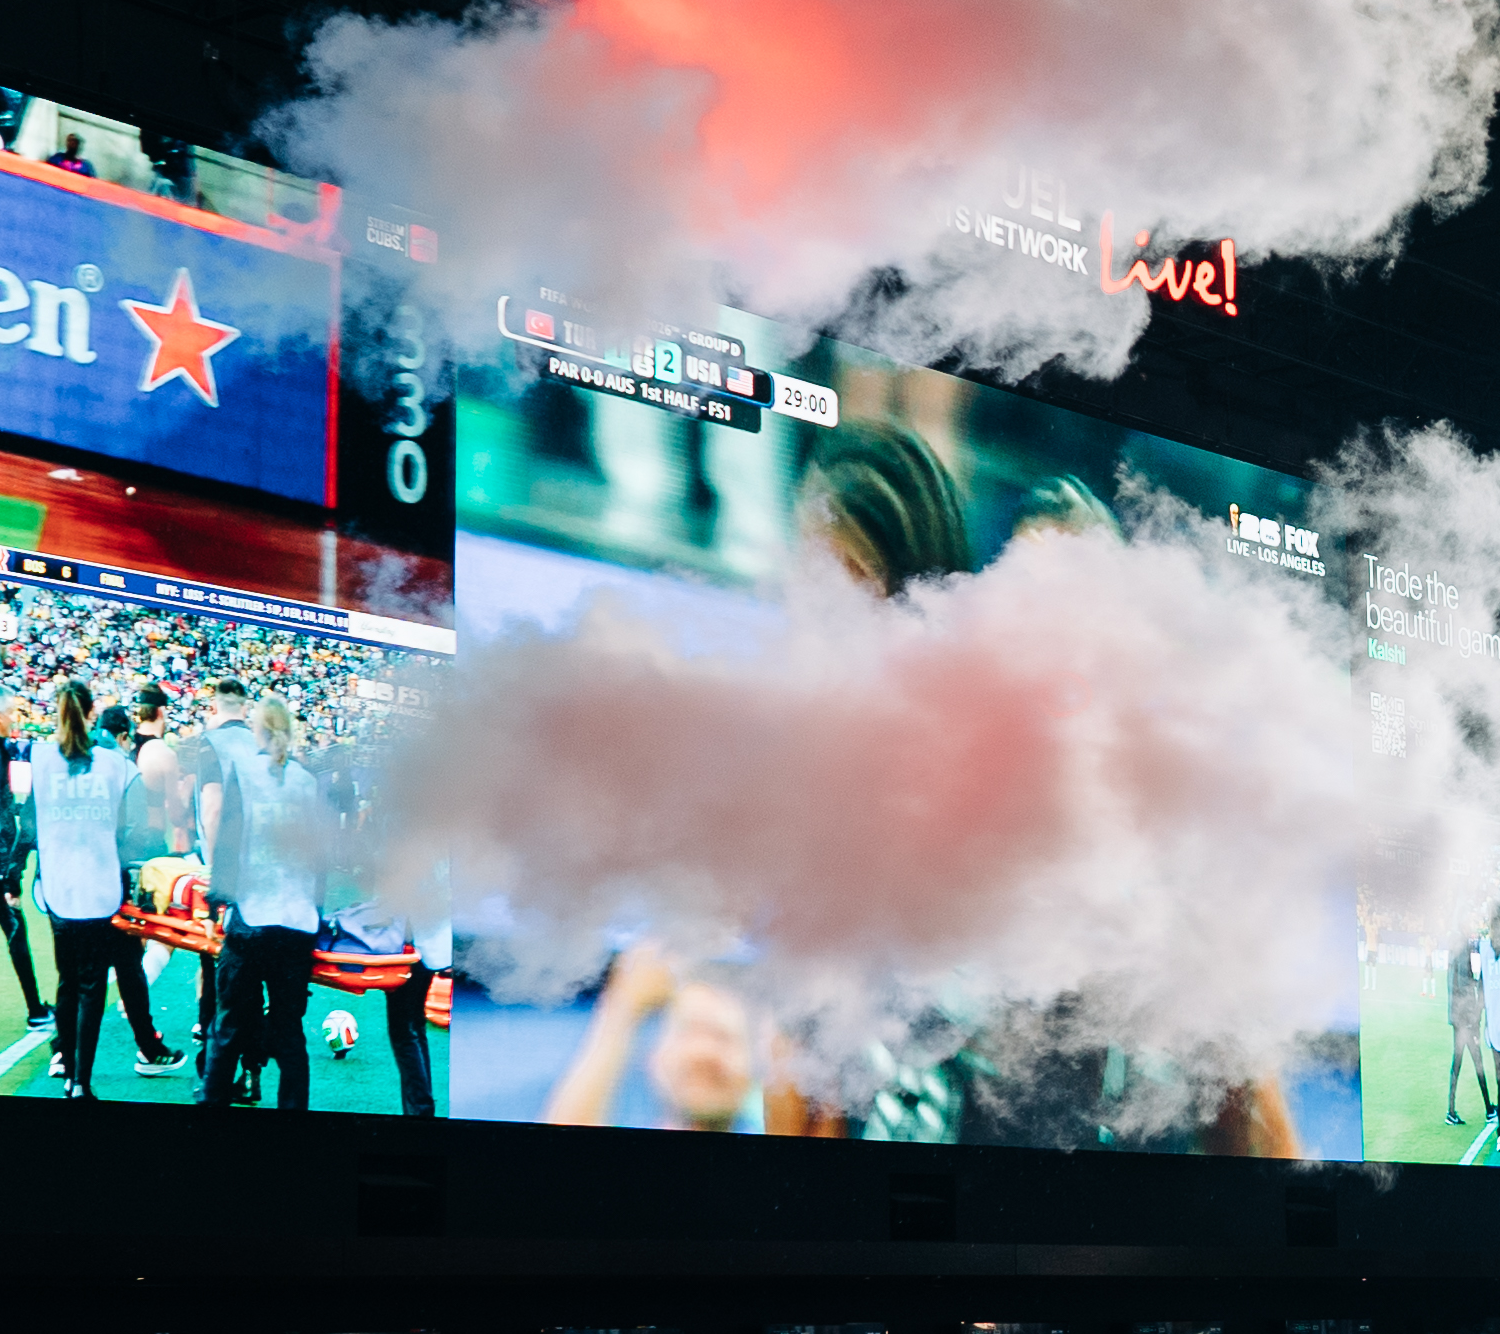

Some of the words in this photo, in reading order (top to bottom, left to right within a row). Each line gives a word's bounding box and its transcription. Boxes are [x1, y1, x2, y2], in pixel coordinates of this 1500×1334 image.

[974, 209, 1090, 277] NETWORK
[688, 330, 730, 355] GROUP
[549, 357, 579, 379] PAR
[604, 372, 636, 395] AUS
[639, 382, 662, 402] 1st
[663, 388, 699, 411] HALF
[685, 355, 722, 387] USA
[783, 387, 828, 415] 29:00
[1226, 537, 1251, 558] LIVE
[1257, 545, 1279, 565] LOS
[1279, 552, 1326, 577] ANGELES
[1284, 523, 1320, 559] FOX
[1363, 552, 1423, 601] Trade
[1425, 570, 1460, 610] the
[1365, 590, 1454, 648] beautiful
[1368, 637, 1407, 666] Kalshi
[50, 772, 112, 799] FIFA
[51, 805, 112, 822] DOCTOR
